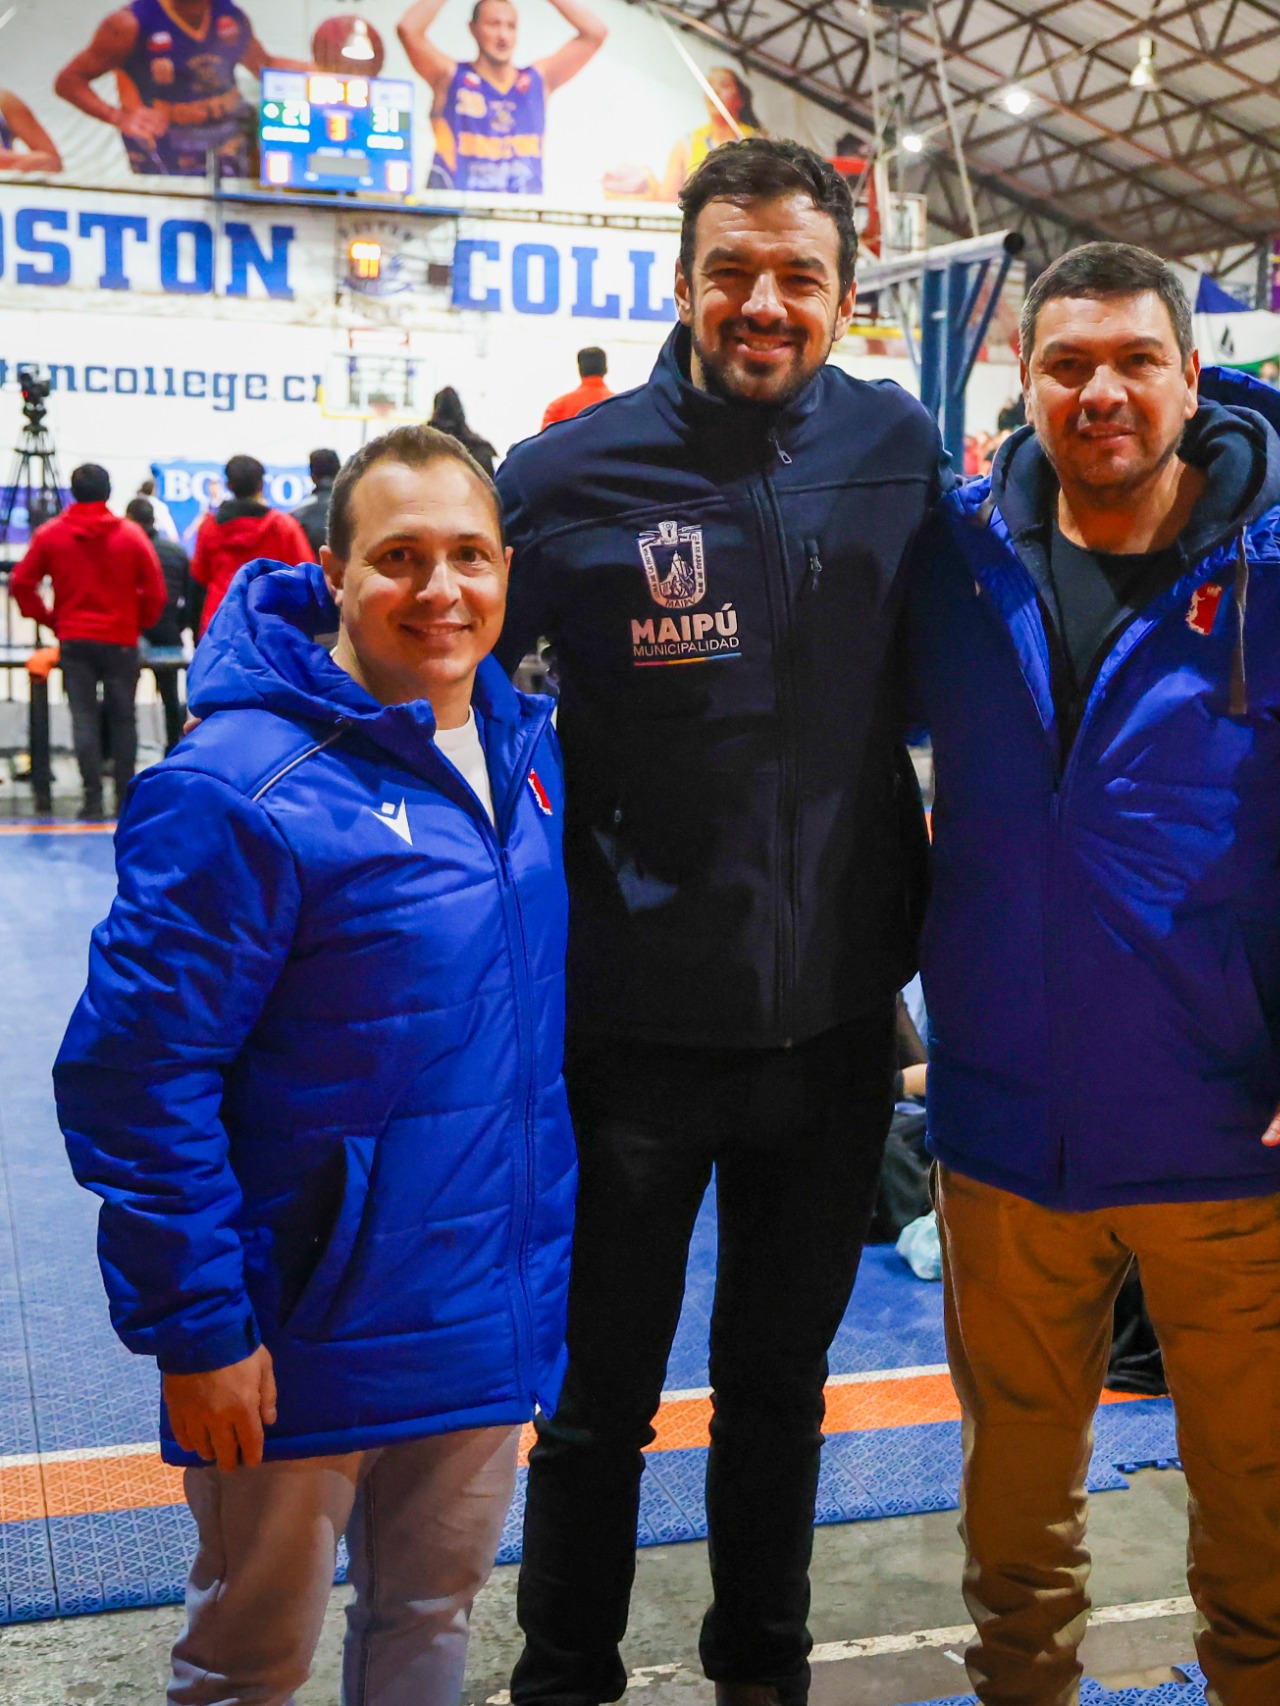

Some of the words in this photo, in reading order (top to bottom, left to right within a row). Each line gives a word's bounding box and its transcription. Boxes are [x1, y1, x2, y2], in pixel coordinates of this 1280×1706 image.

[0, 208, 294, 301] STON
[631, 603, 738, 645] MAIPÚ
[633, 637, 740, 657] MUNICIPALIDAD
